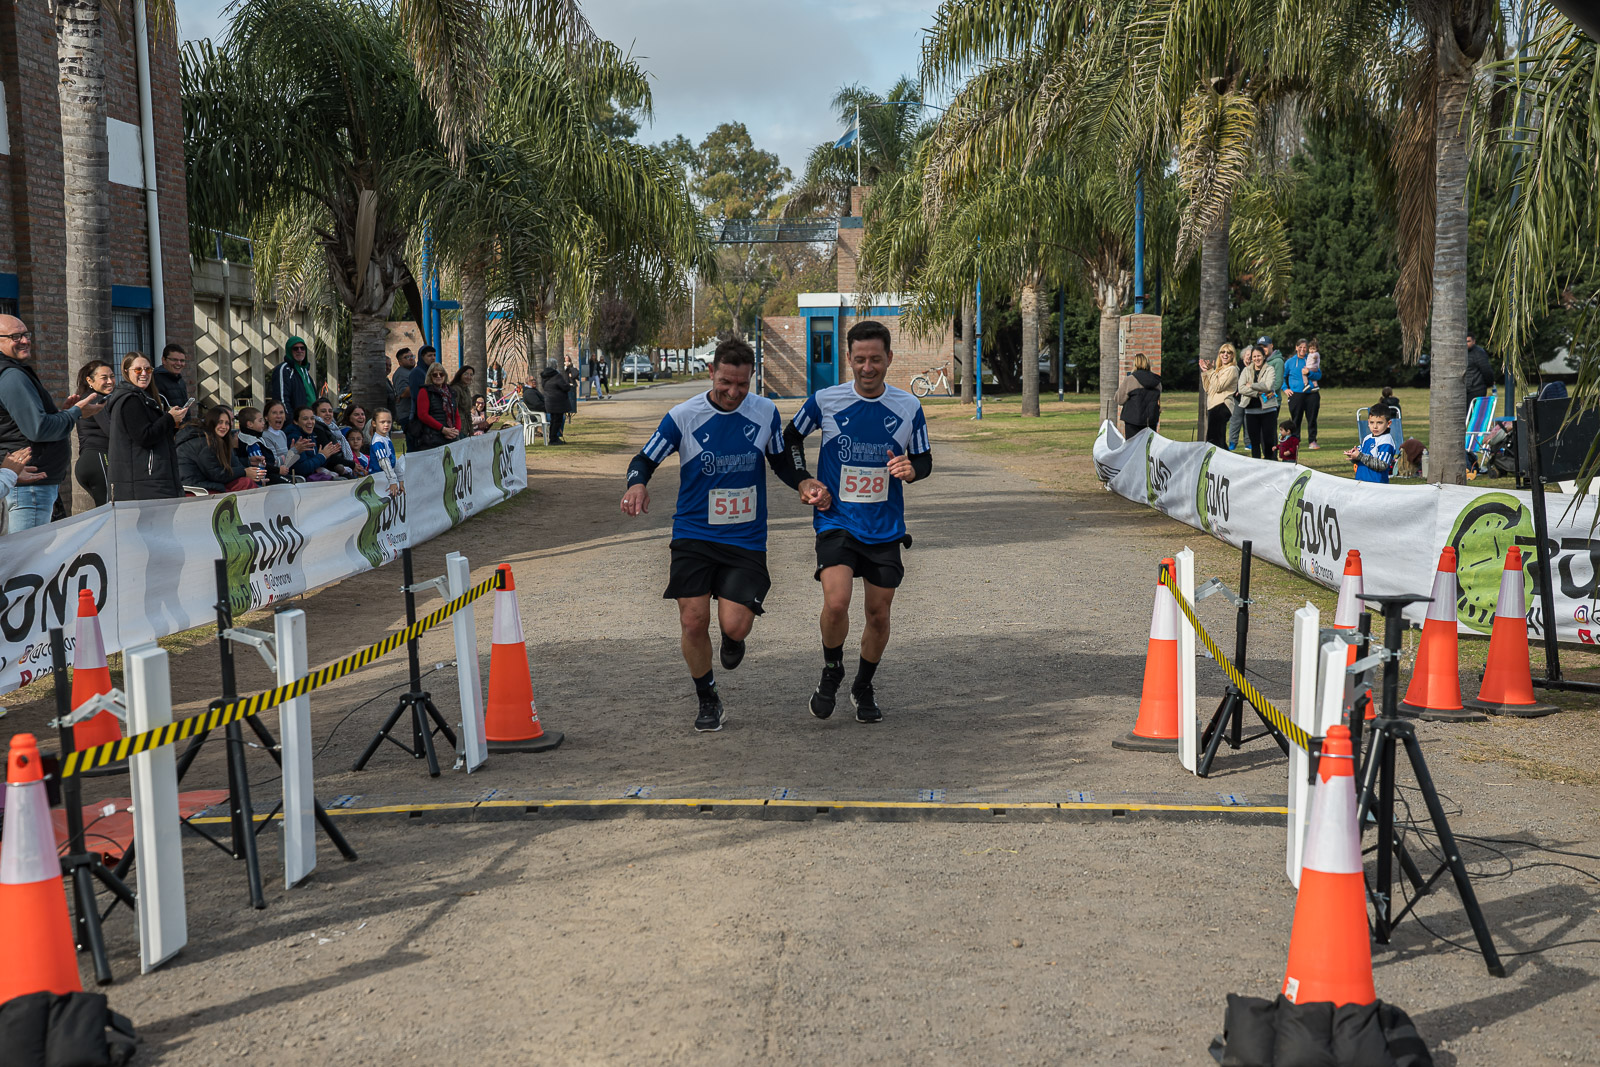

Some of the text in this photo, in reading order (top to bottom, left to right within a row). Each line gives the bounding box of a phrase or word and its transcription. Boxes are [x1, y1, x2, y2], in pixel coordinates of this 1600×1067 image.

[837, 434, 852, 463] 3
[700, 451, 716, 476] 3
[844, 475, 885, 494] 528
[714, 496, 752, 516] 511
